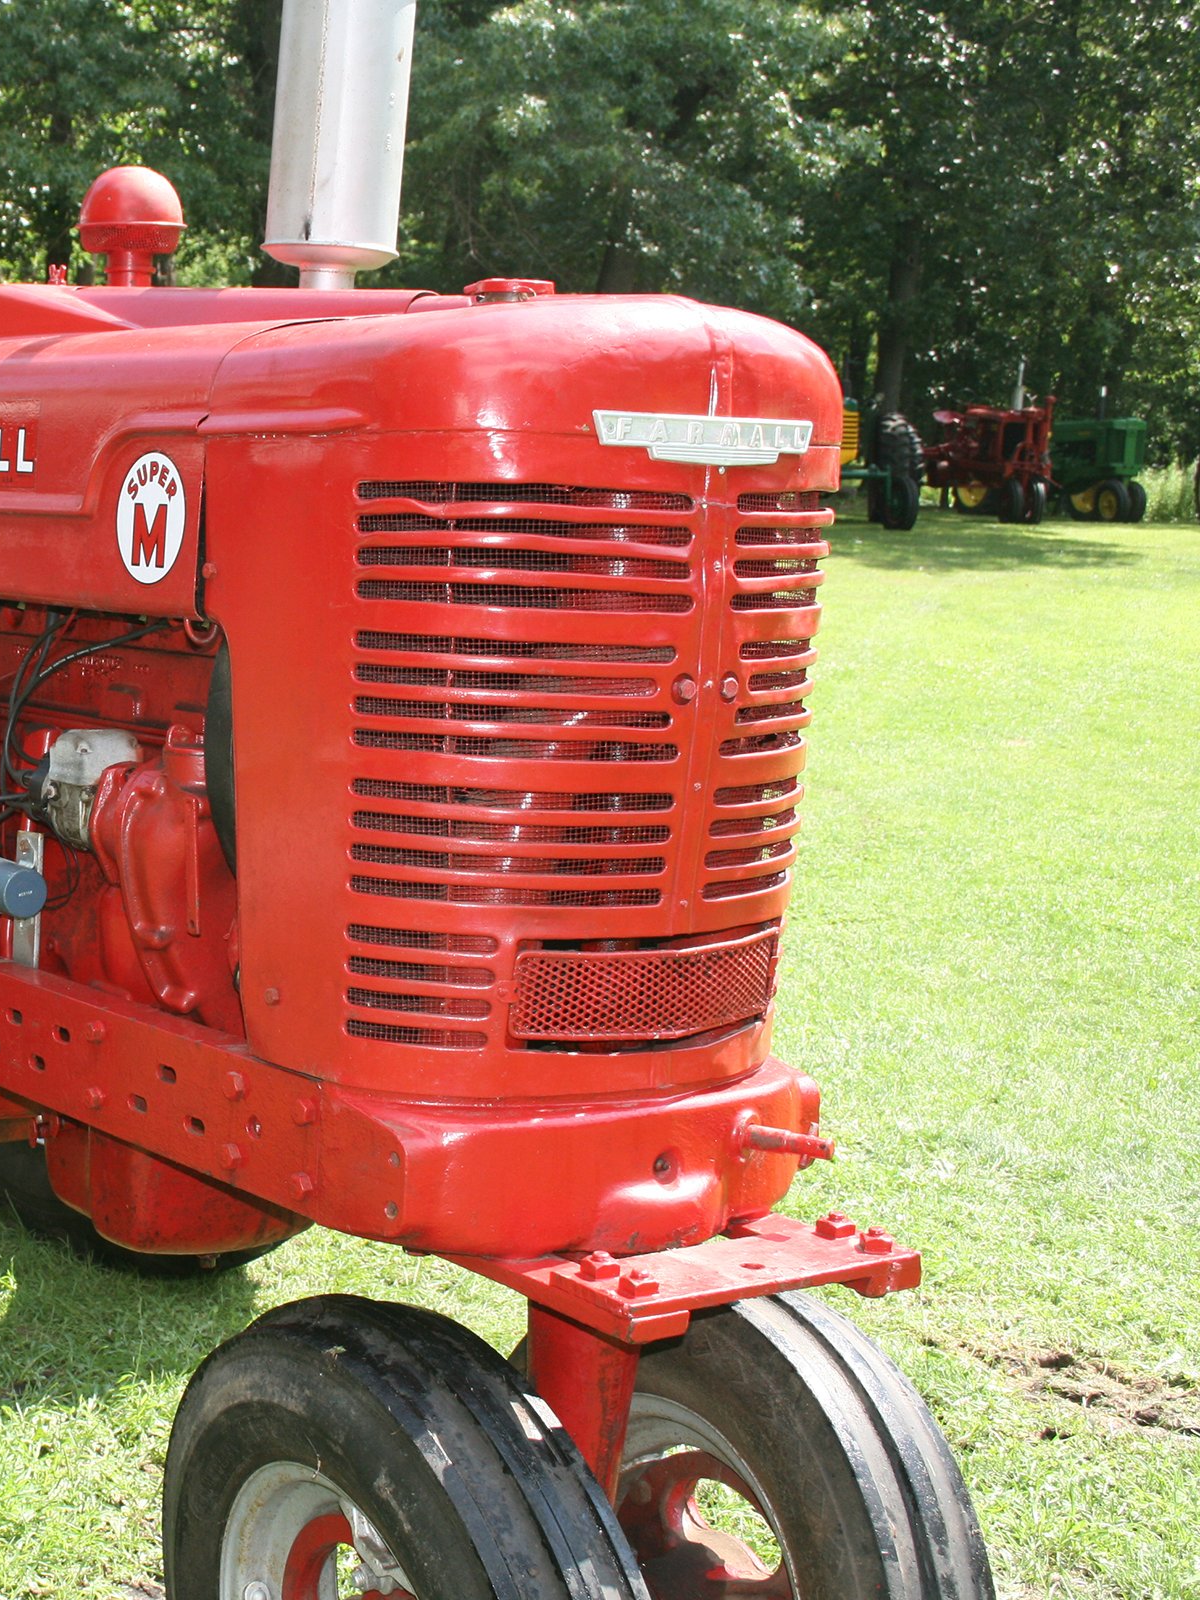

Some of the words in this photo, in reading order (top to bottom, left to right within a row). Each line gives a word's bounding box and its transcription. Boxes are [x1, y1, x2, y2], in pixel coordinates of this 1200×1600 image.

[616, 417, 805, 448] FARMALL
[127, 461, 178, 502] SUPER
[131, 503, 168, 569] M
